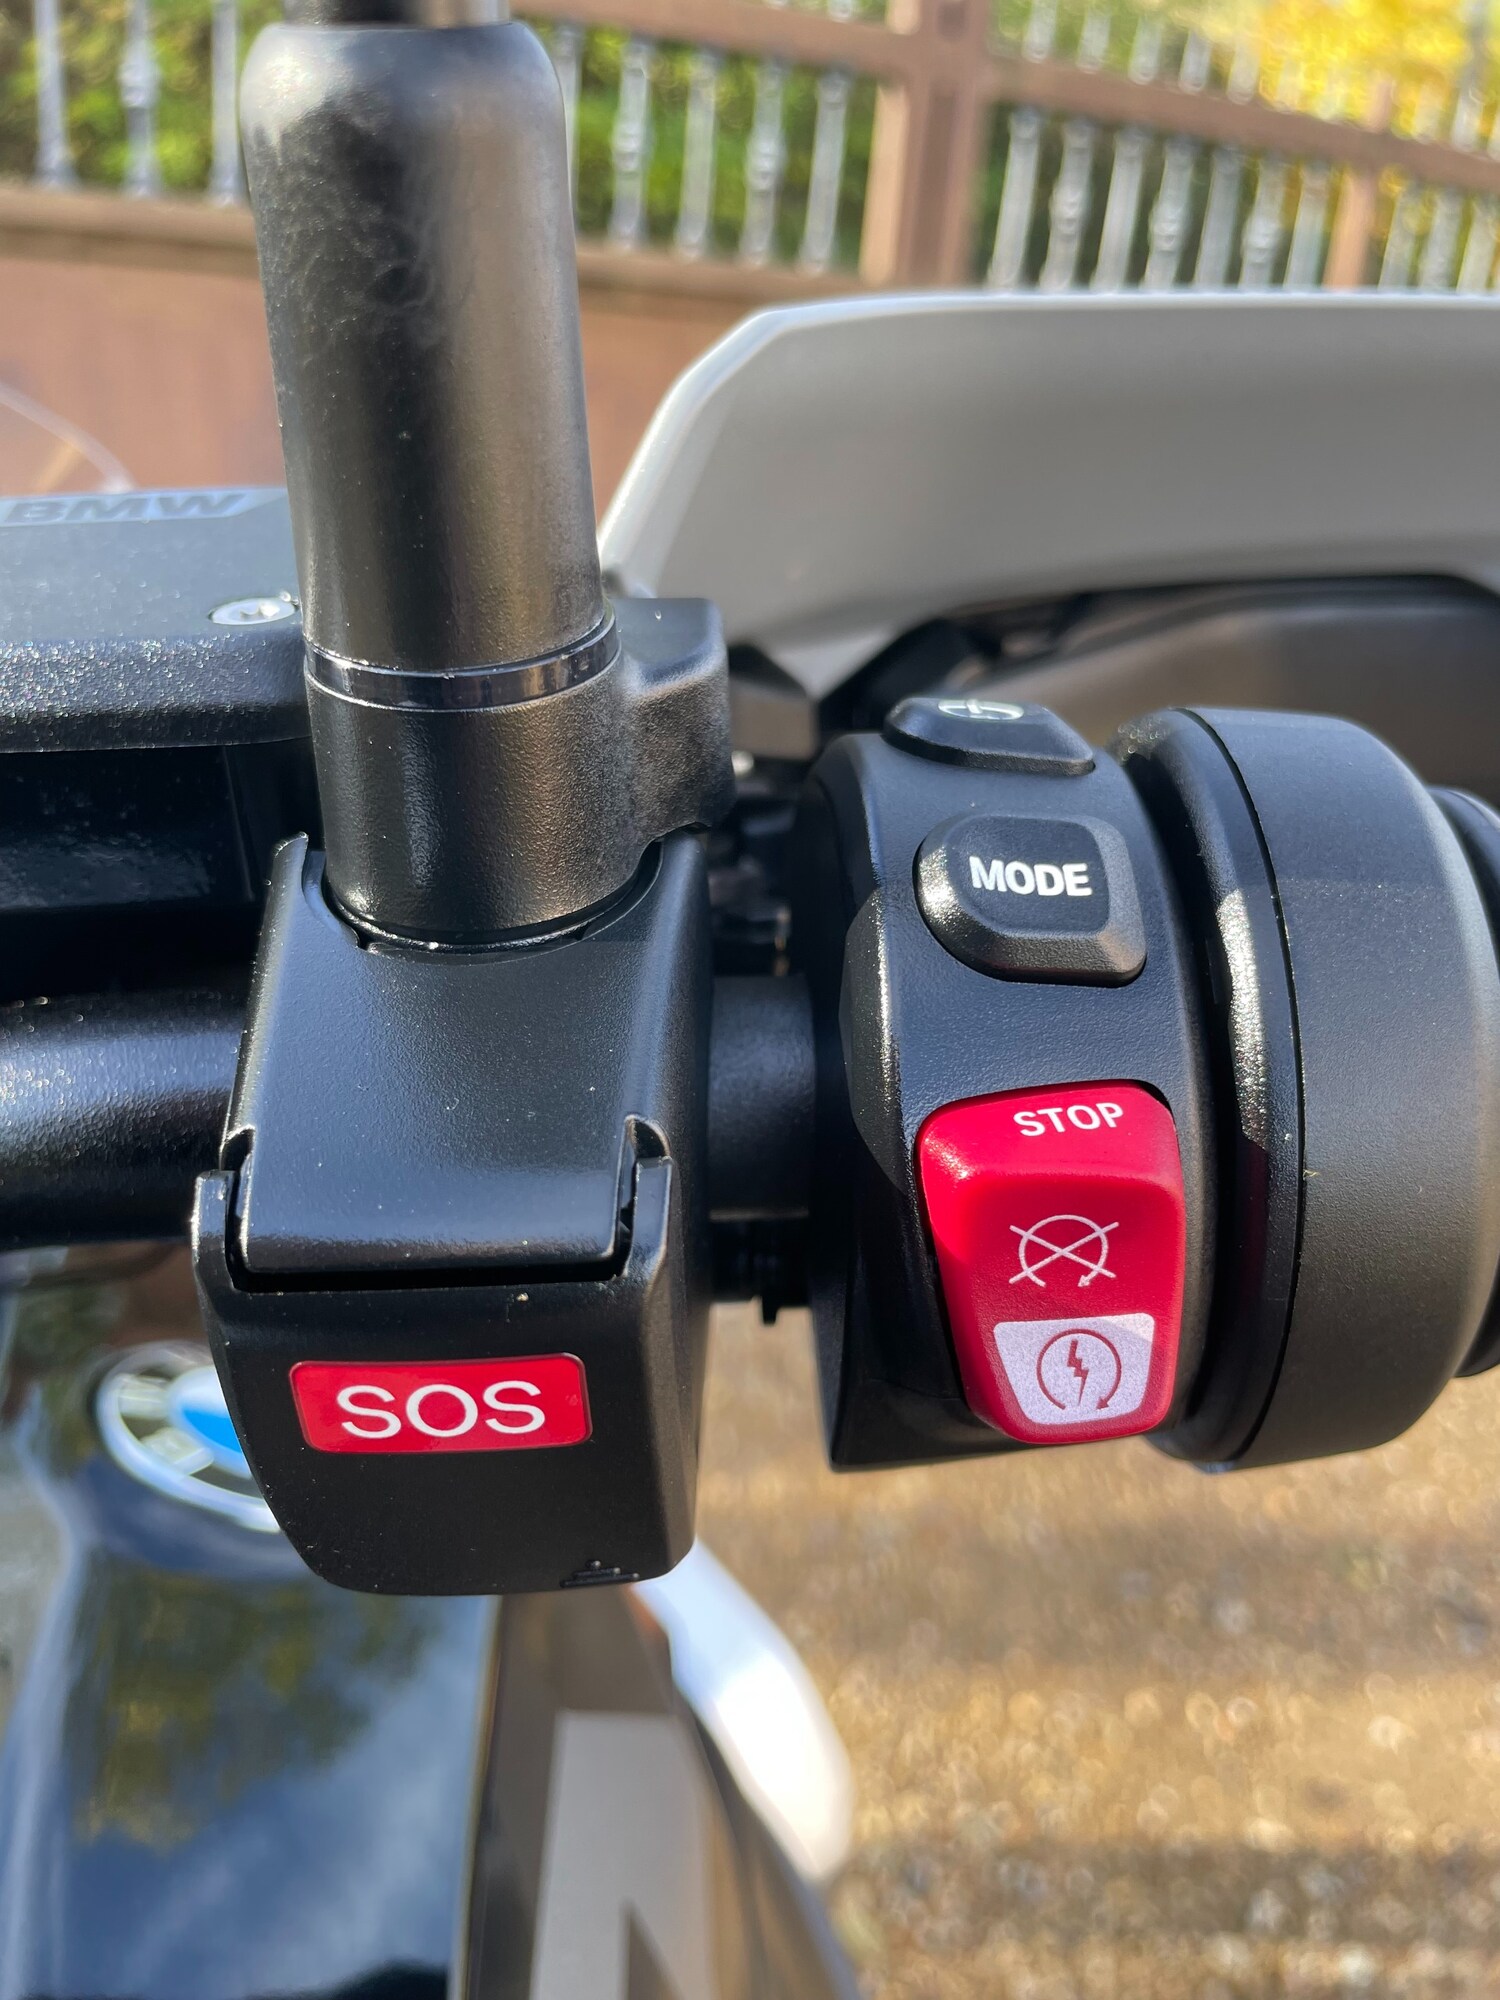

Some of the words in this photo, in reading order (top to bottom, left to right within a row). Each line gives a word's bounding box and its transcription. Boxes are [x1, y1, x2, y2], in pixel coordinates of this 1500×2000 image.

[4, 493, 246, 523] BMW
[969, 856, 1092, 896] MODE
[1013, 1103, 1123, 1136] STOP
[336, 1380, 545, 1438] SOS
